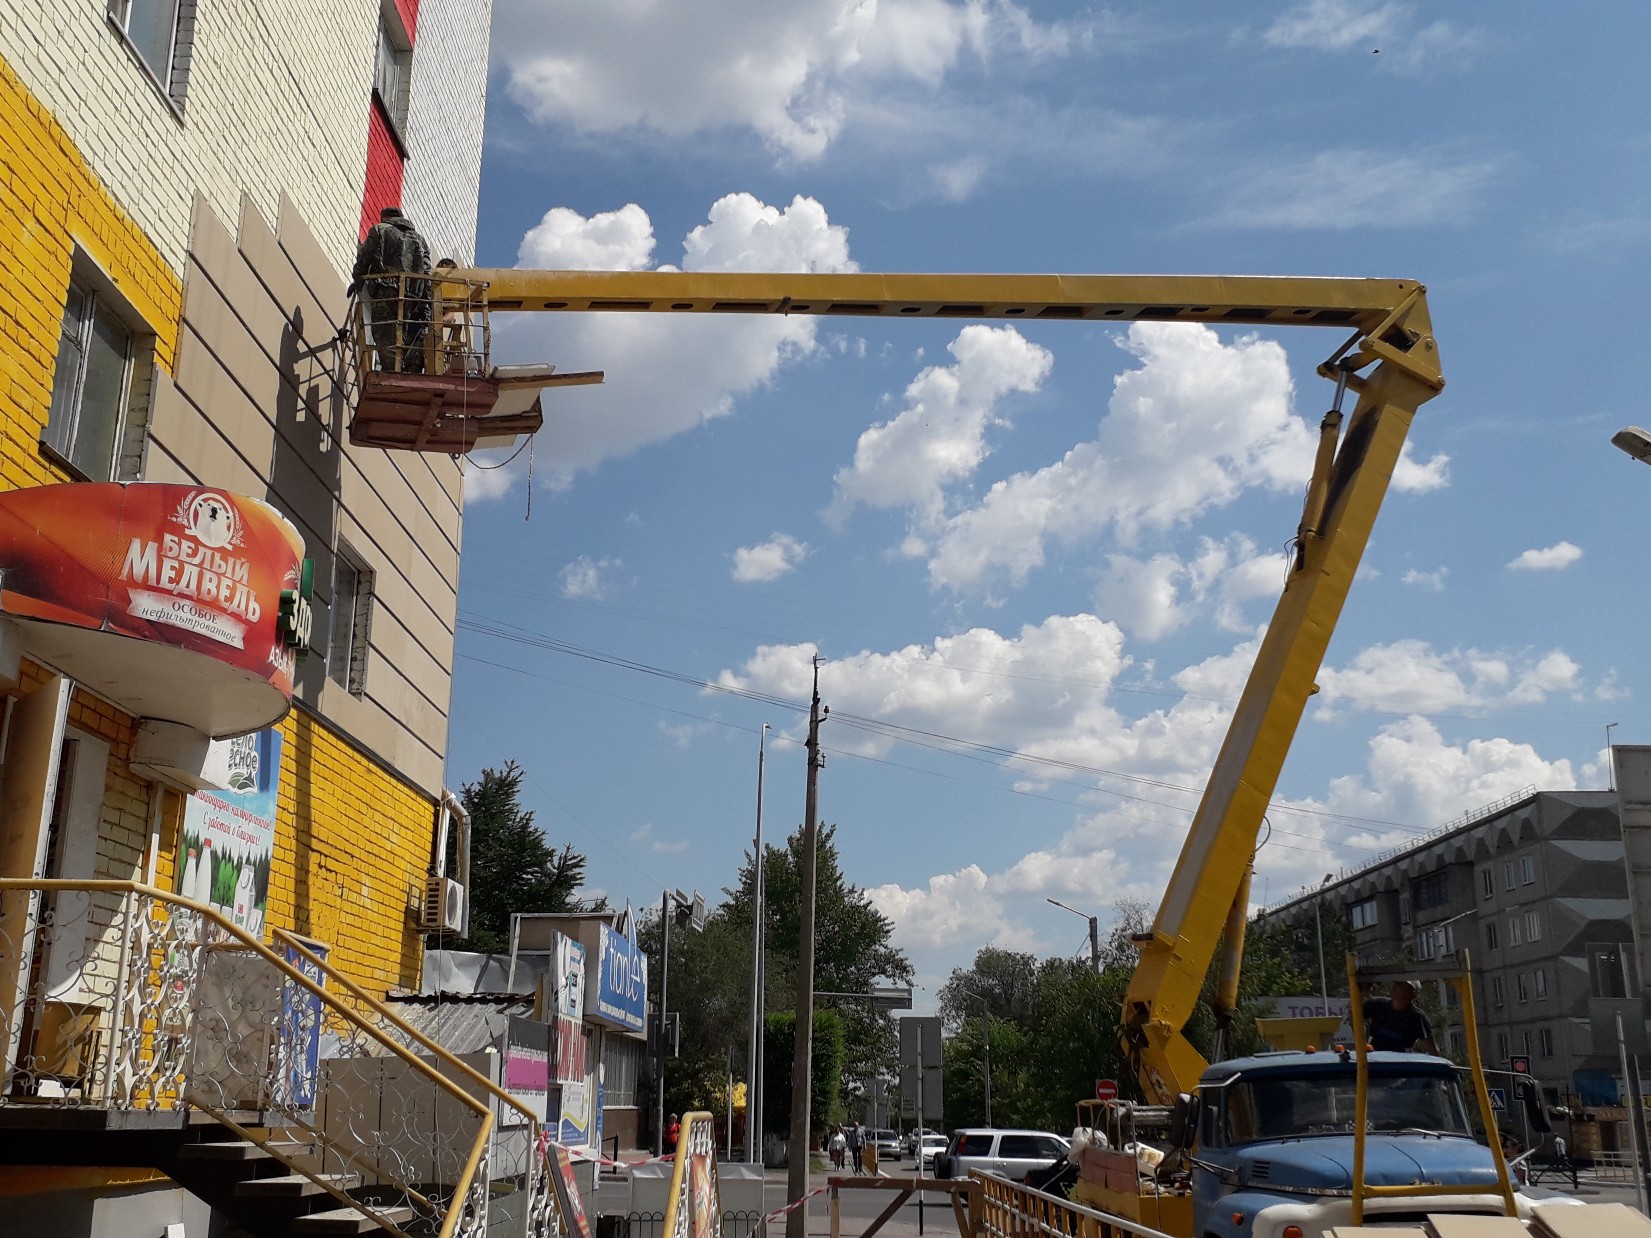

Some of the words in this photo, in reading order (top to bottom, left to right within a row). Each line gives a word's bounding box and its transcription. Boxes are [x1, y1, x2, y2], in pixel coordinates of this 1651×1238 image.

[118, 537, 261, 623] МЕДВЕДЬ
[160, 532, 250, 587] БЕЛЫЙ
[141, 607, 237, 643] нефильтрованное
[172, 601, 219, 625] ОСОБОЕ
